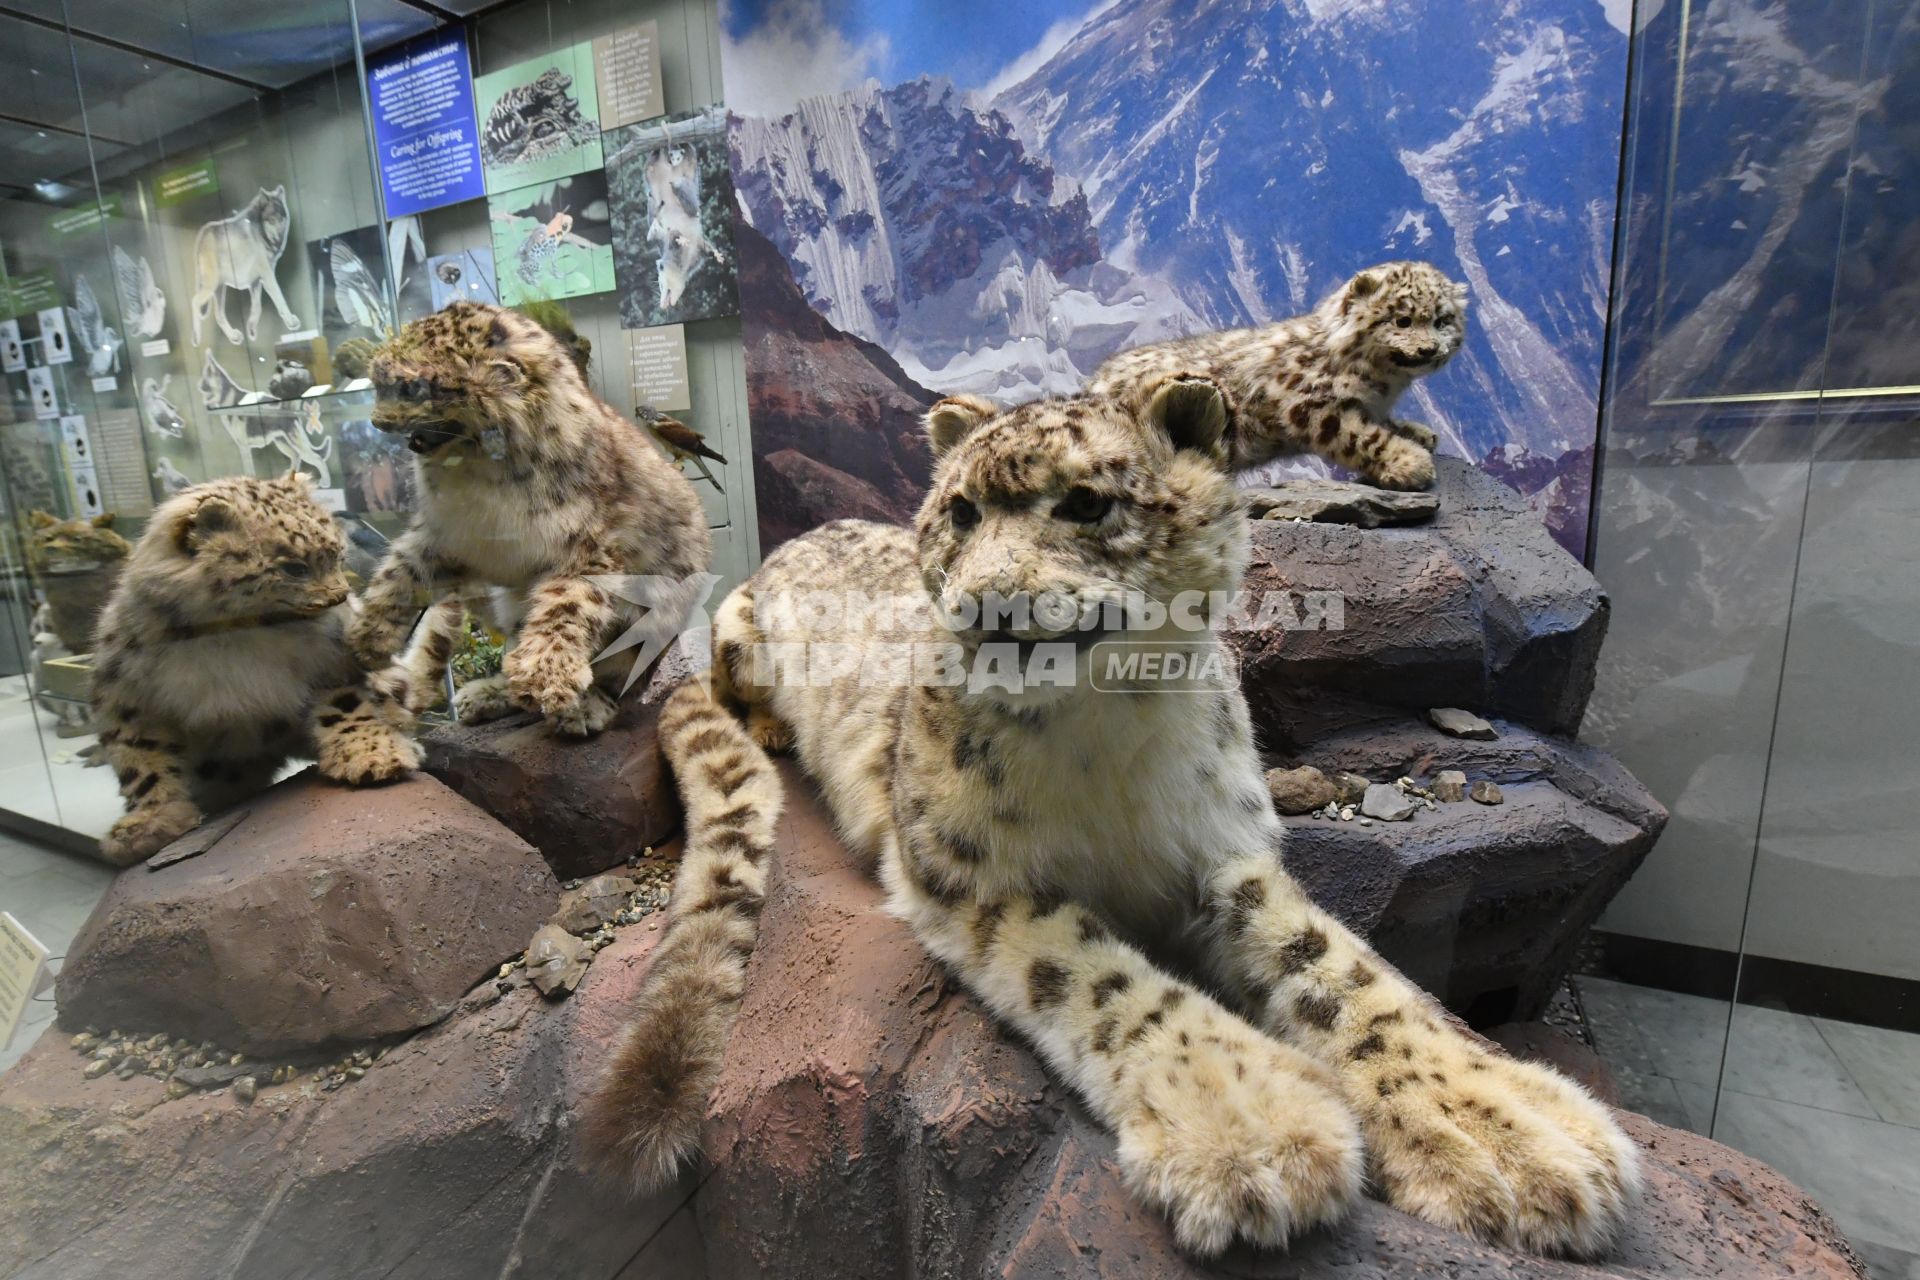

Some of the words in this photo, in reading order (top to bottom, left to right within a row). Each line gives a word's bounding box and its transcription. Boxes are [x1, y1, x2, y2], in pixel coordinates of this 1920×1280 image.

[390, 145, 417, 158] Caring
[415, 137, 426, 154] for
[427, 128, 463, 149] Offspring
